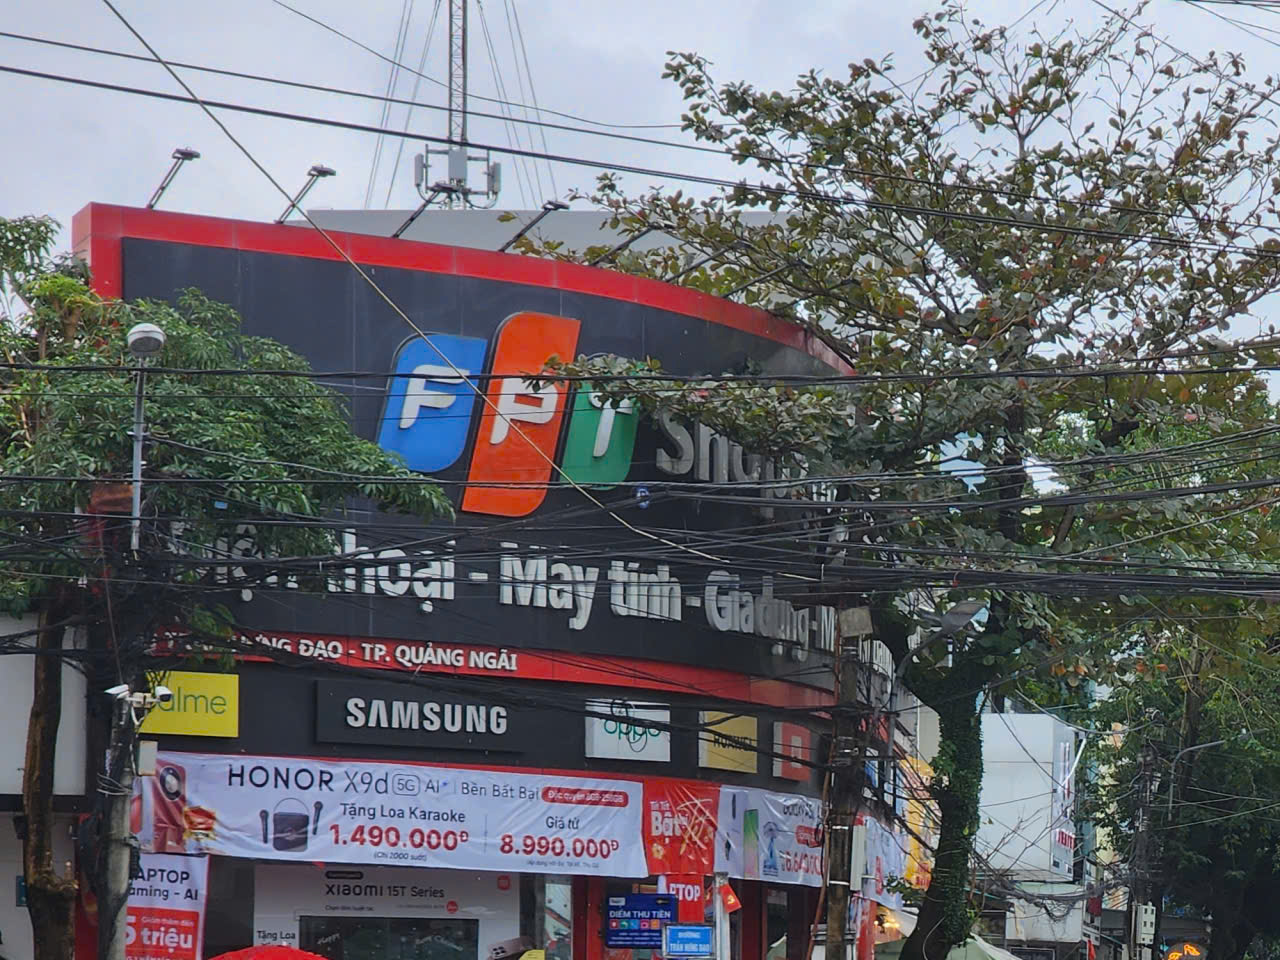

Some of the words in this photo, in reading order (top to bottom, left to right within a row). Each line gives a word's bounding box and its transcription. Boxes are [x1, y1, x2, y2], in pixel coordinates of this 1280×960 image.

[361, 642, 391, 663] TP.
[395, 640, 464, 669] QUẢNG
[468, 646, 519, 672] NGÃI
[158, 686, 227, 715] alme
[346, 697, 508, 735] SAMSUNG
[227, 763, 335, 792] HONOR
[343, 770, 389, 795] X9d
[396, 777, 416, 792] 5G
[461, 782, 487, 798] Bền
[492, 784, 516, 799] Bất
[340, 802, 376, 820] Tặng
[380, 804, 405, 819] Loa
[408, 806, 466, 823] Karaoke
[545, 815, 566, 830] Giá
[134, 868, 191, 885] APTOP
[129, 886, 170, 901] aming
[184, 888, 199, 901] AI
[387, 885, 407, 897] 15T
[410, 886, 445, 898] Series
[140, 926, 194, 953] triệu
[257, 930, 278, 942] Tặng
[280, 931, 296, 940] Loa
